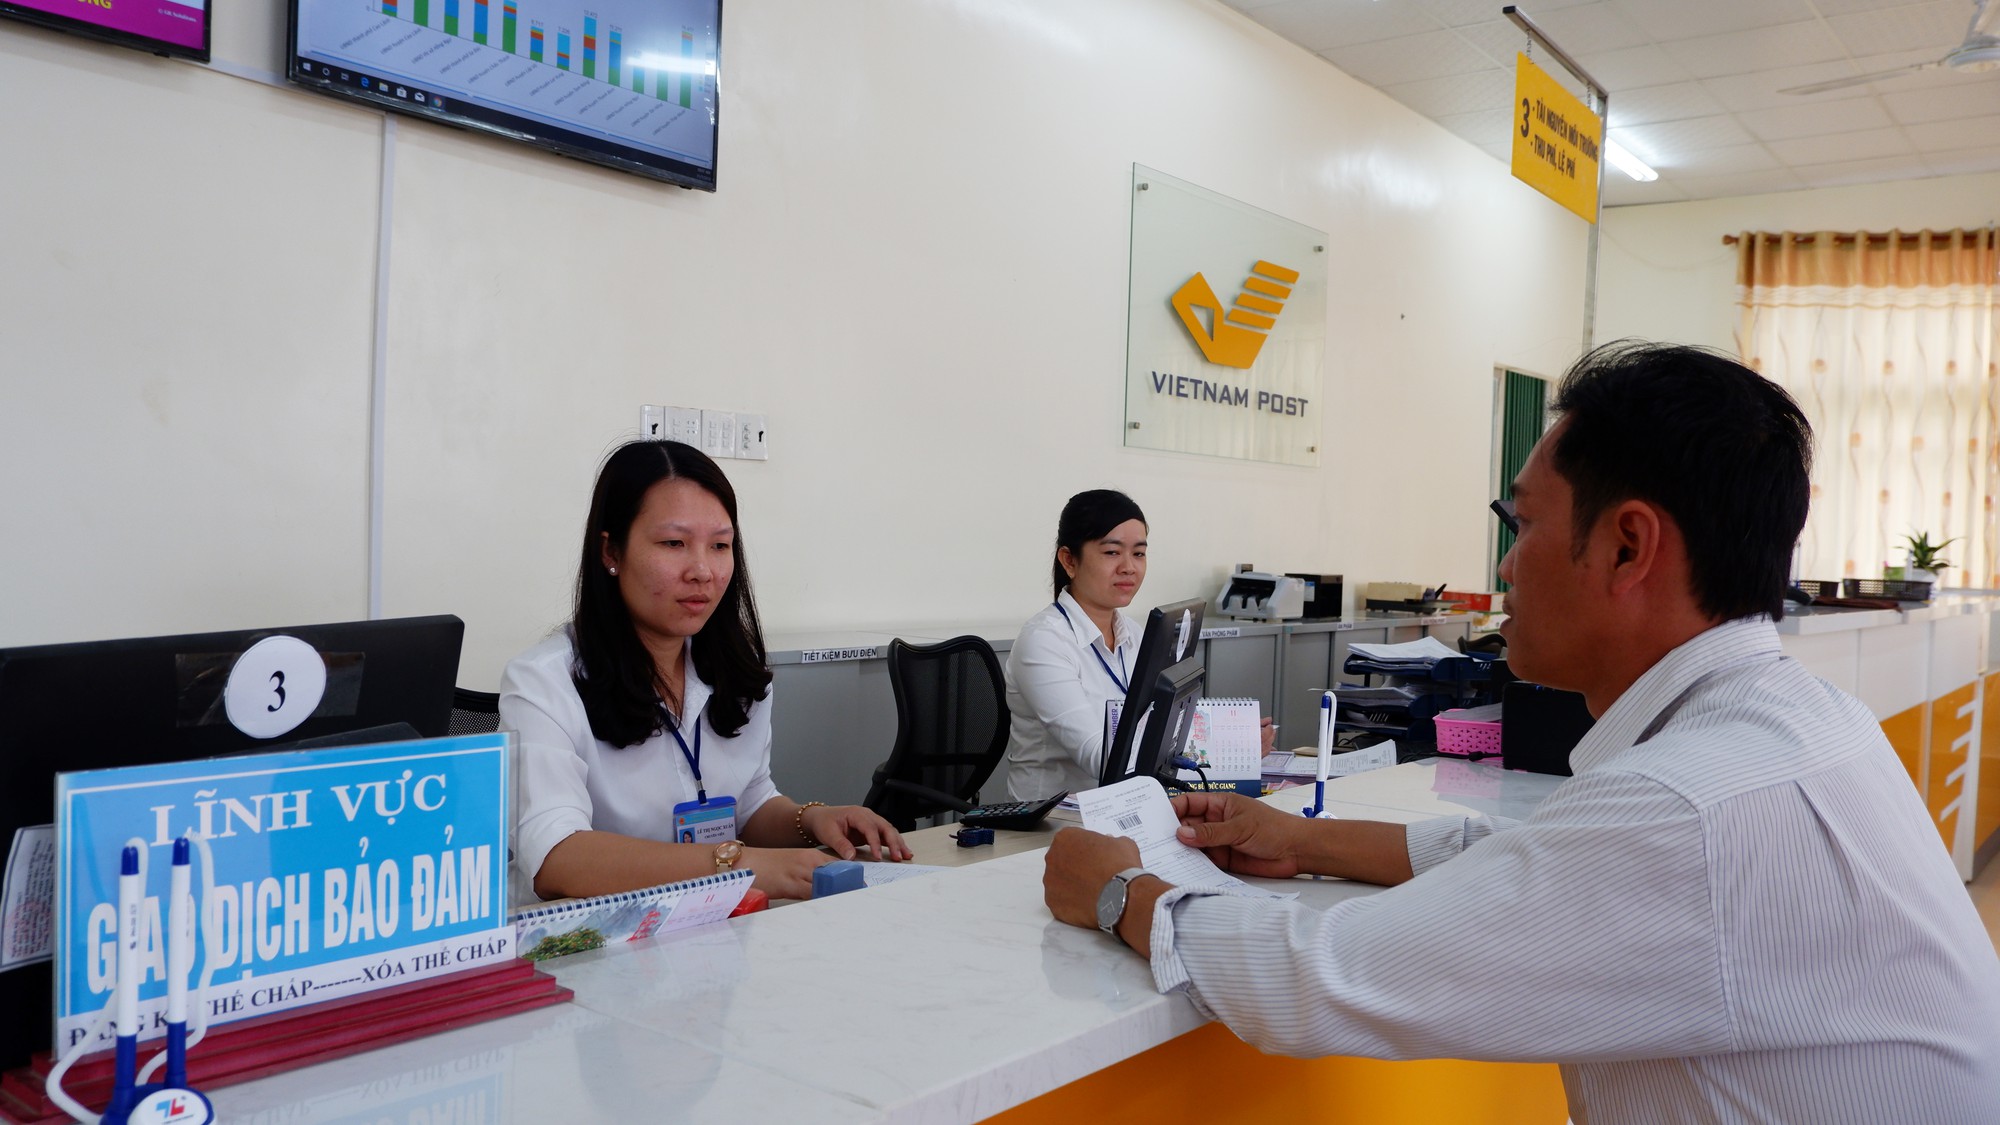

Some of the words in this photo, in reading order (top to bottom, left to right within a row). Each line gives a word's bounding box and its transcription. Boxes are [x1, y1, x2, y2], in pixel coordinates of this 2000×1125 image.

[1520, 98, 1530, 138] 3
[1534, 134, 1546, 160] THU
[1566, 158, 1576, 180] PHÍ
[1152, 371, 1248, 408] VIETNAM
[1258, 391, 1308, 418] POST
[267, 670, 286, 712] 3
[1111, 708, 1119, 738] OVEMBER
[150, 789, 312, 847] LĨNH
[330, 769, 446, 826] VỰC
[212, 872, 310, 980] DỊCH
[324, 836, 400, 949] BẢO
[410, 824, 490, 932] ĐẢM
[412, 945, 450, 974] THẾ
[456, 937, 508, 963] CHẤP
